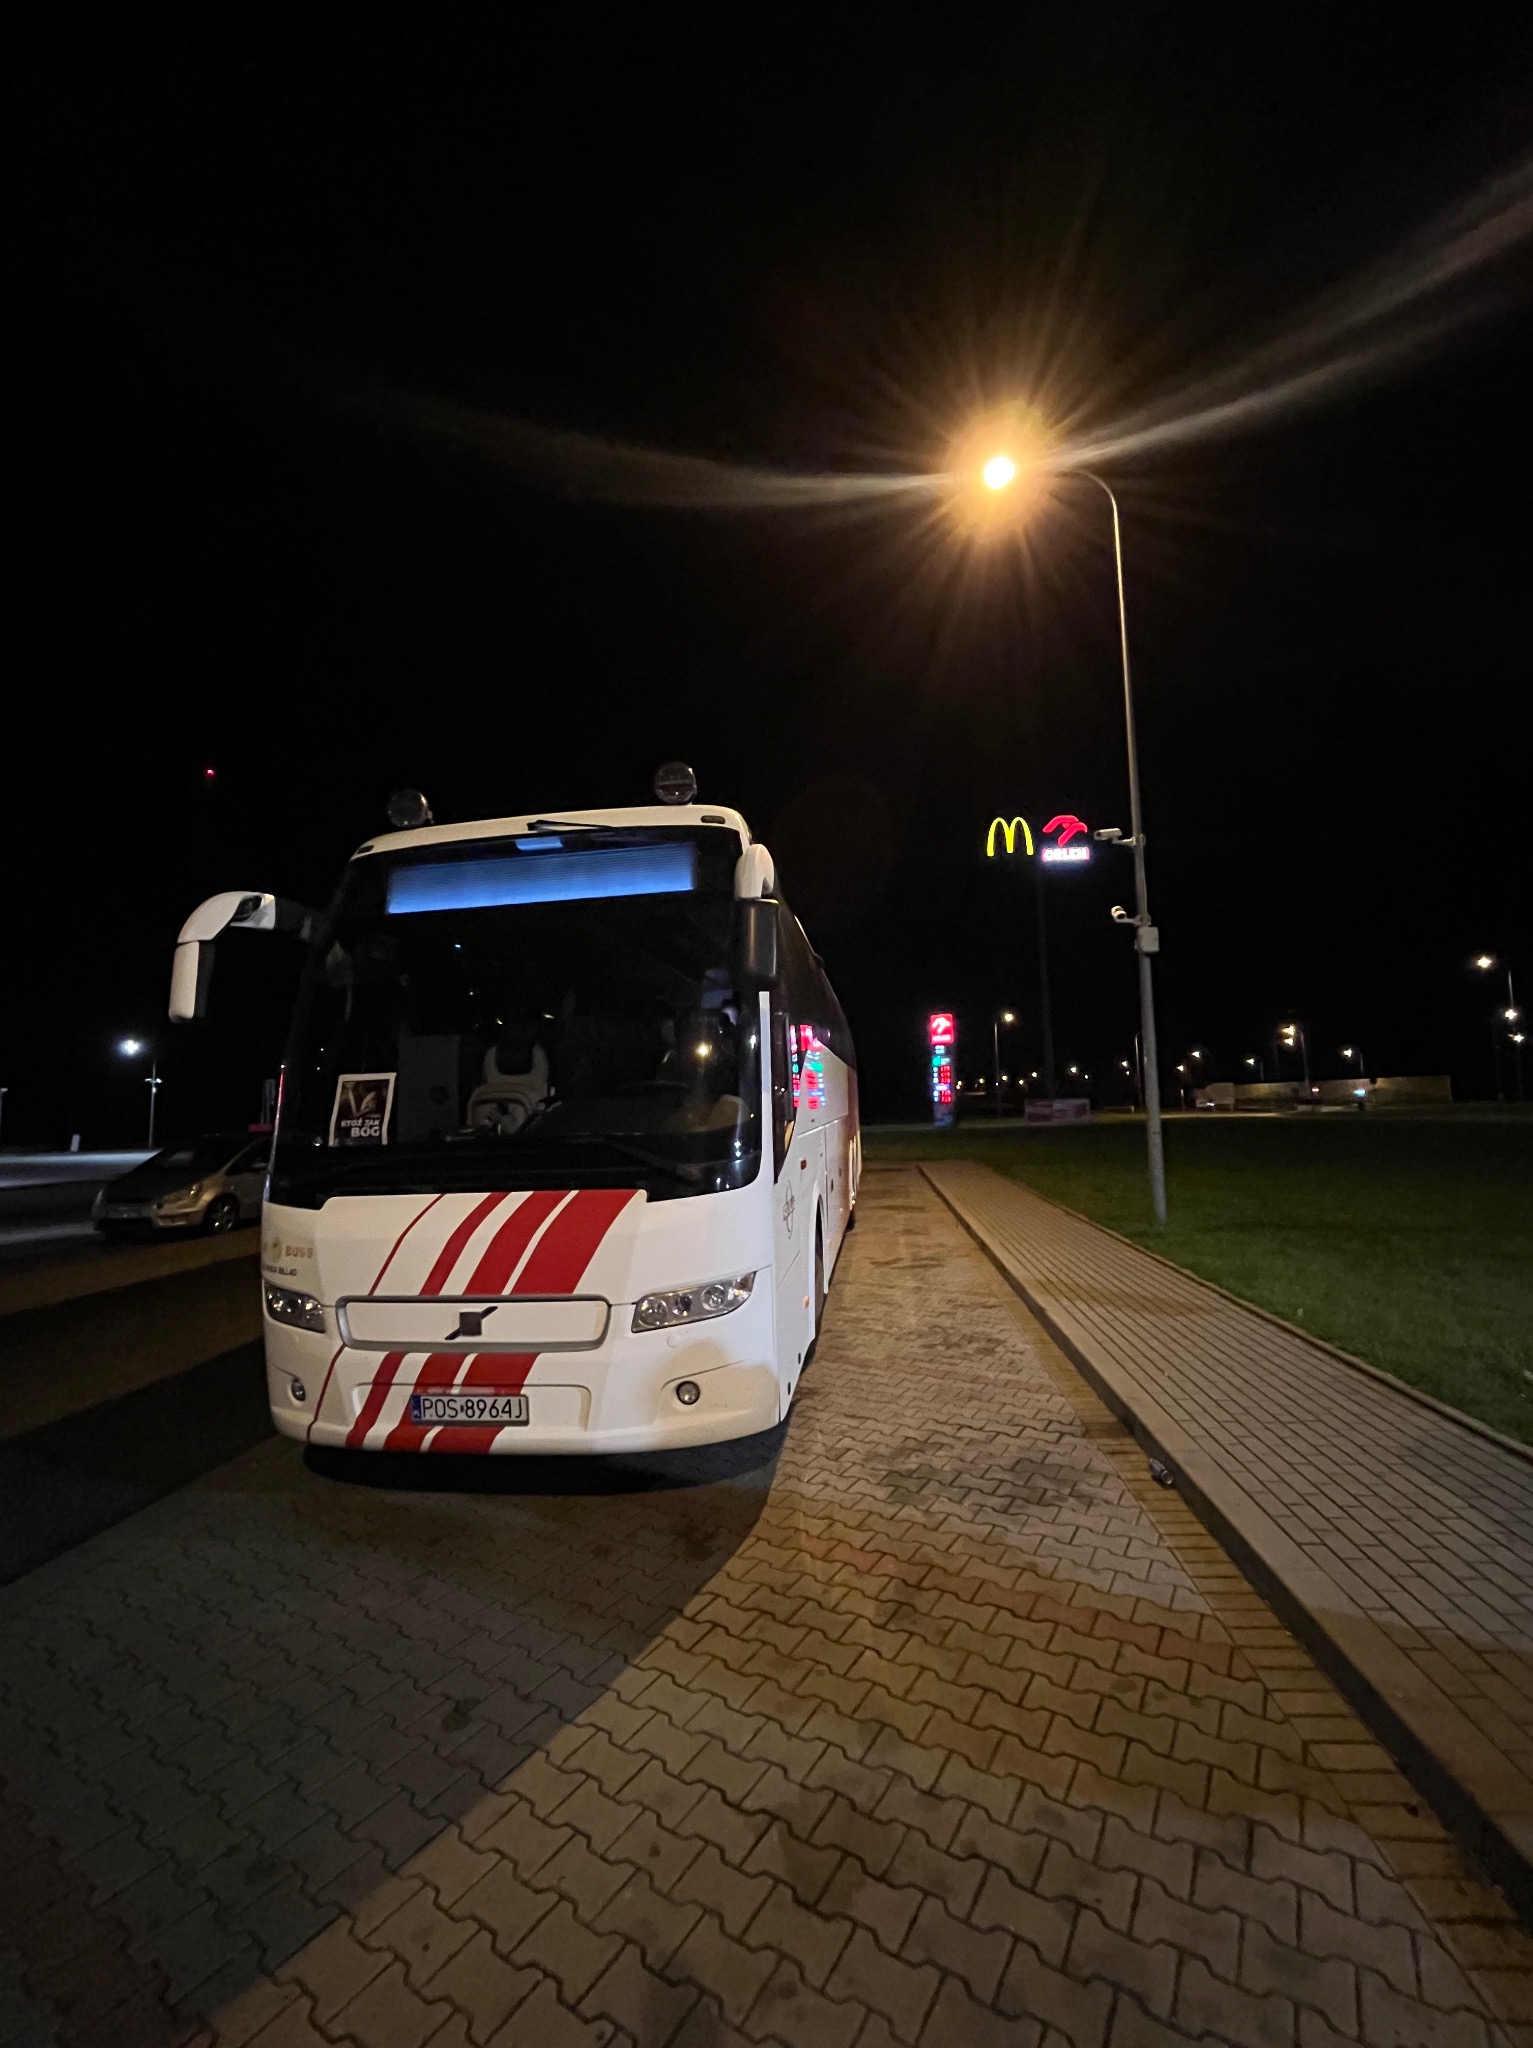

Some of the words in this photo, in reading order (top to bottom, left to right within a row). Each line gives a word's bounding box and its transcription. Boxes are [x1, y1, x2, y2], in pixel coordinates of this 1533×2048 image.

[987, 817, 1034, 857] M
[1042, 847, 1090, 862] ORLEN
[422, 1398, 459, 1419] POS
[465, 1398, 522, 1419] 8964J
